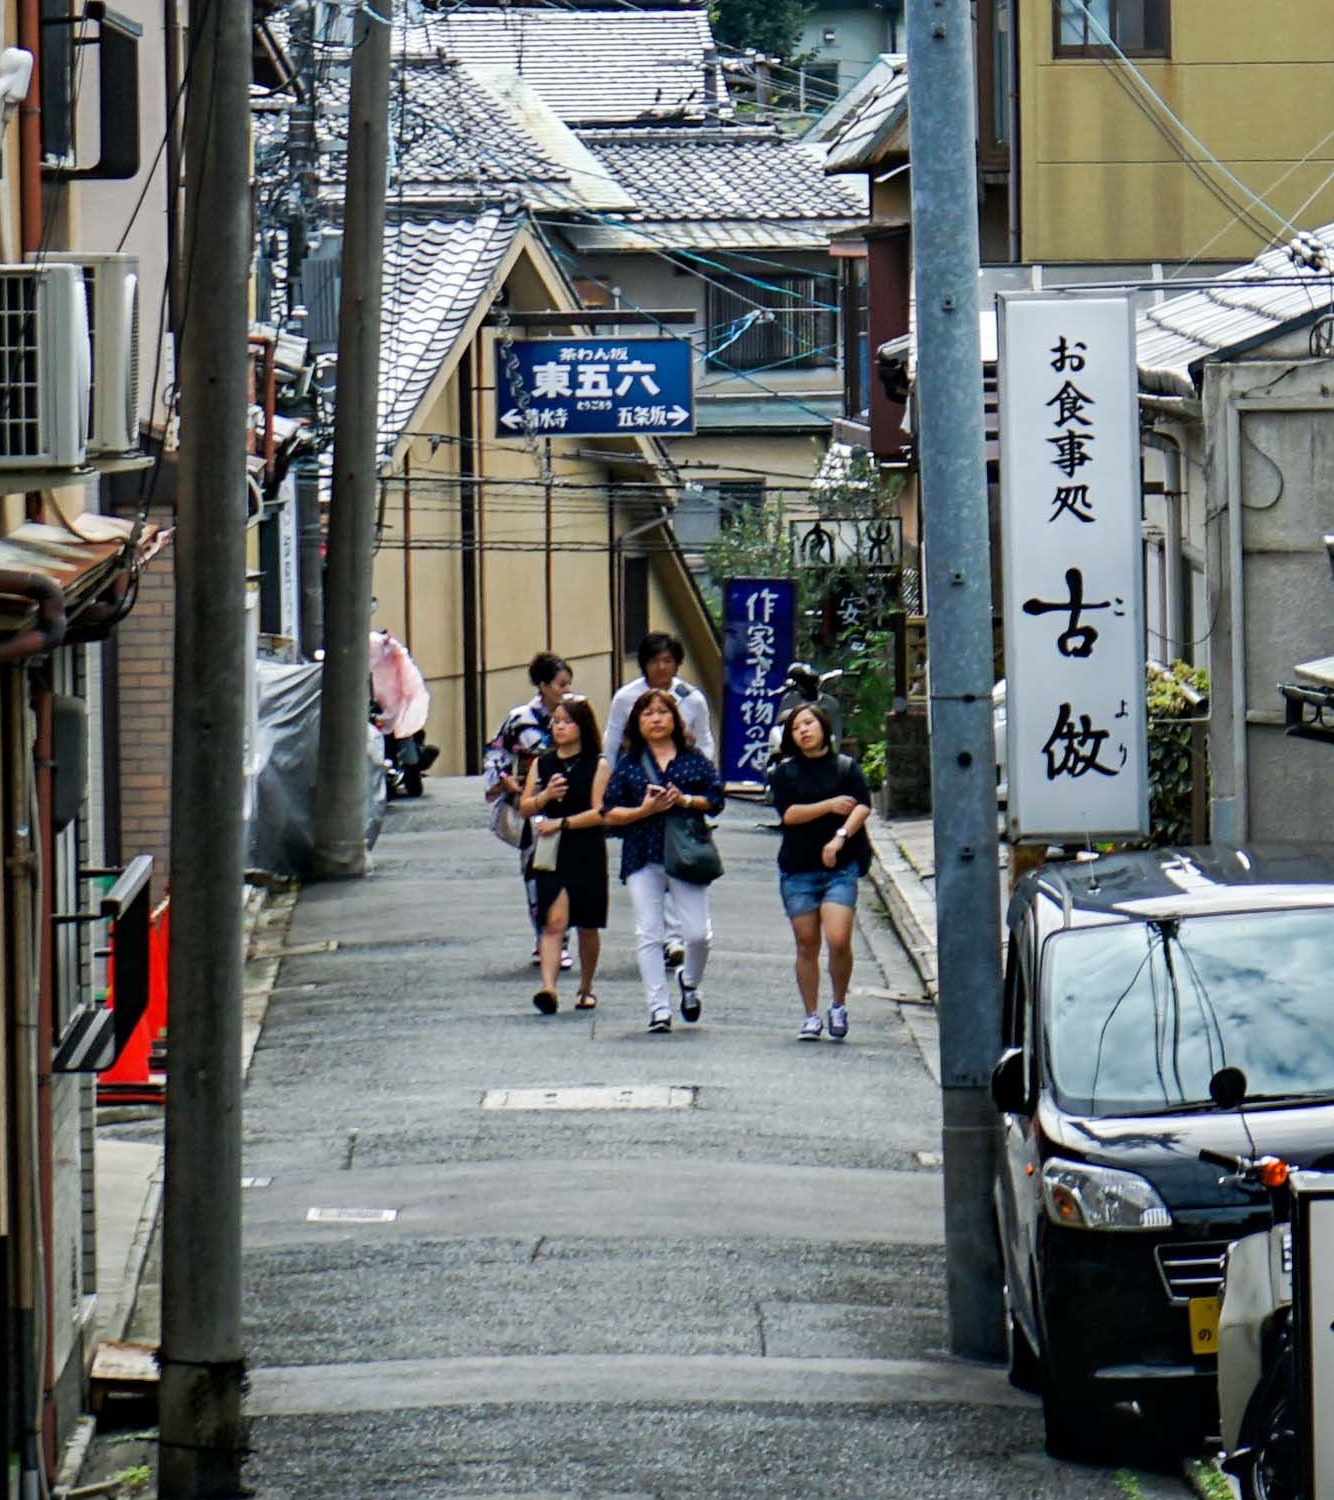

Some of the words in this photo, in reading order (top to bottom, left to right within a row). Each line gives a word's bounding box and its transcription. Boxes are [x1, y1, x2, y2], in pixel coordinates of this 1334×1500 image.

[559, 347, 629, 361] 茶わん坂
[531, 360, 661, 399] 東五六
[618, 405, 667, 428] 五条坂
[1045, 336, 1097, 523] お食事処
